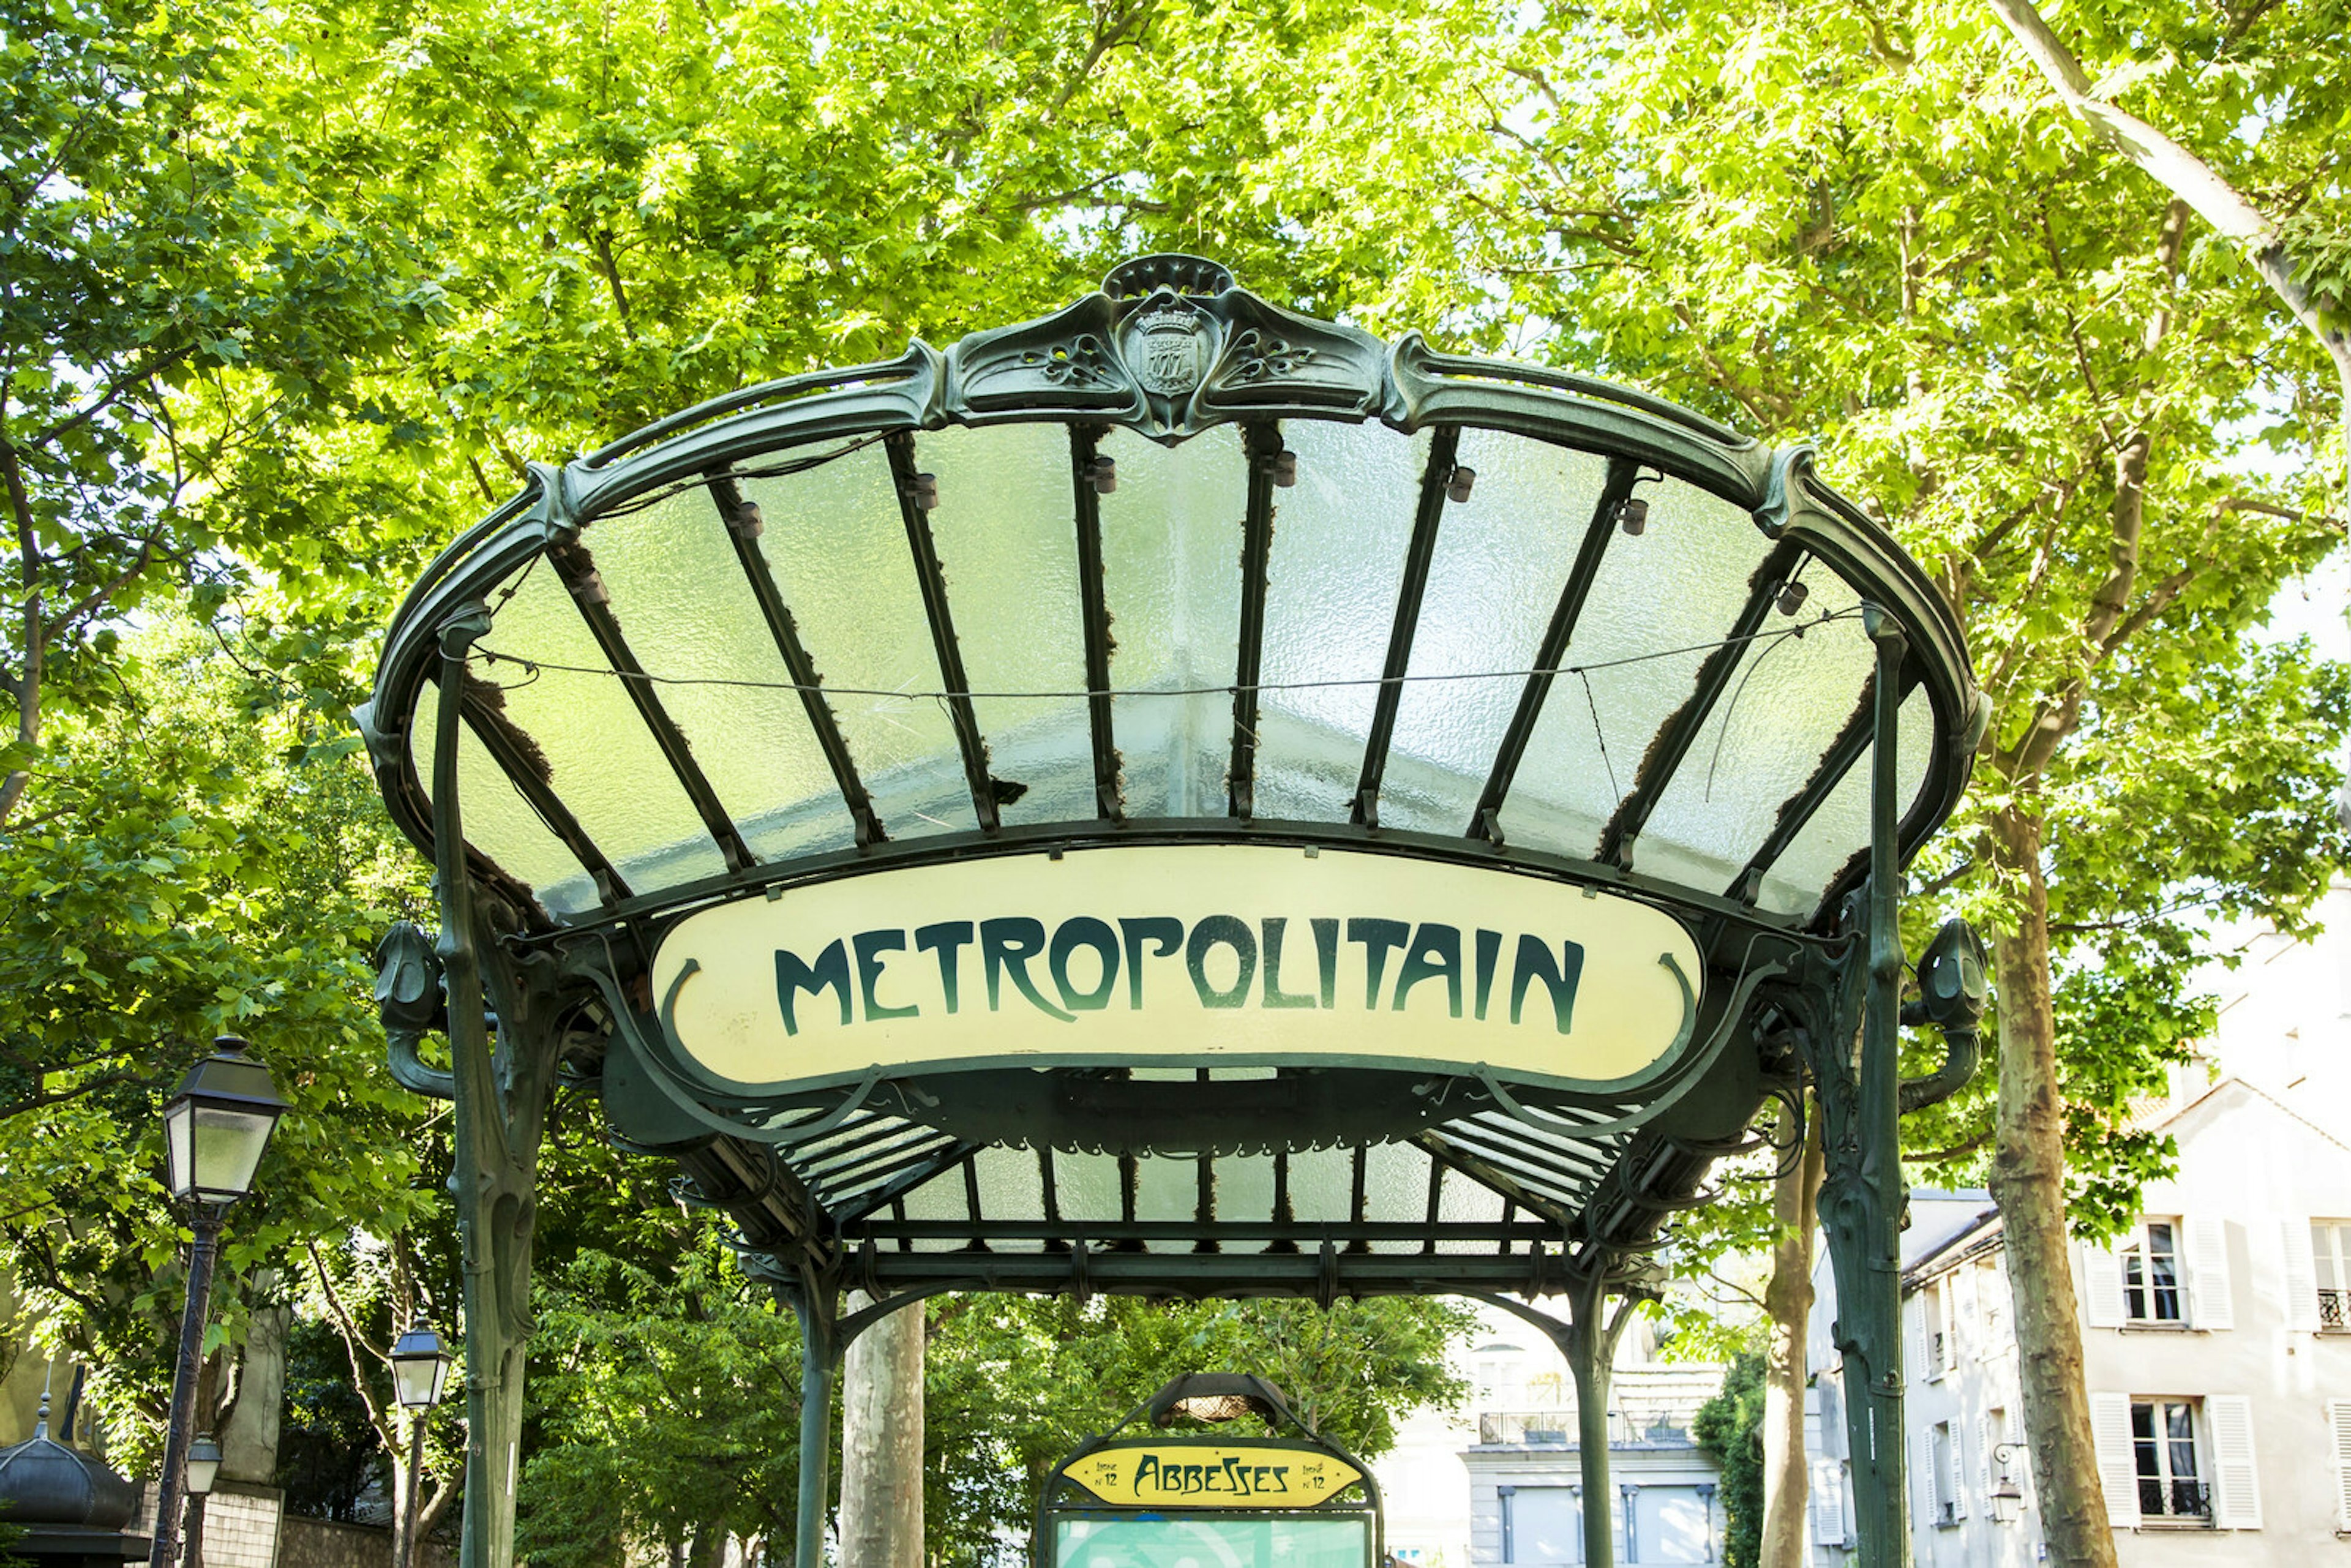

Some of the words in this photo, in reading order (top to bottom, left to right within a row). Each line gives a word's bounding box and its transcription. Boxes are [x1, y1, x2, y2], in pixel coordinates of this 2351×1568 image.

[774, 915, 1584, 1037] METROPOLITAIN
[1104, 1472, 1117, 1487] 12
[1134, 1454, 1289, 1497] ABBESSES
[1312, 1476, 1324, 1489] 12
